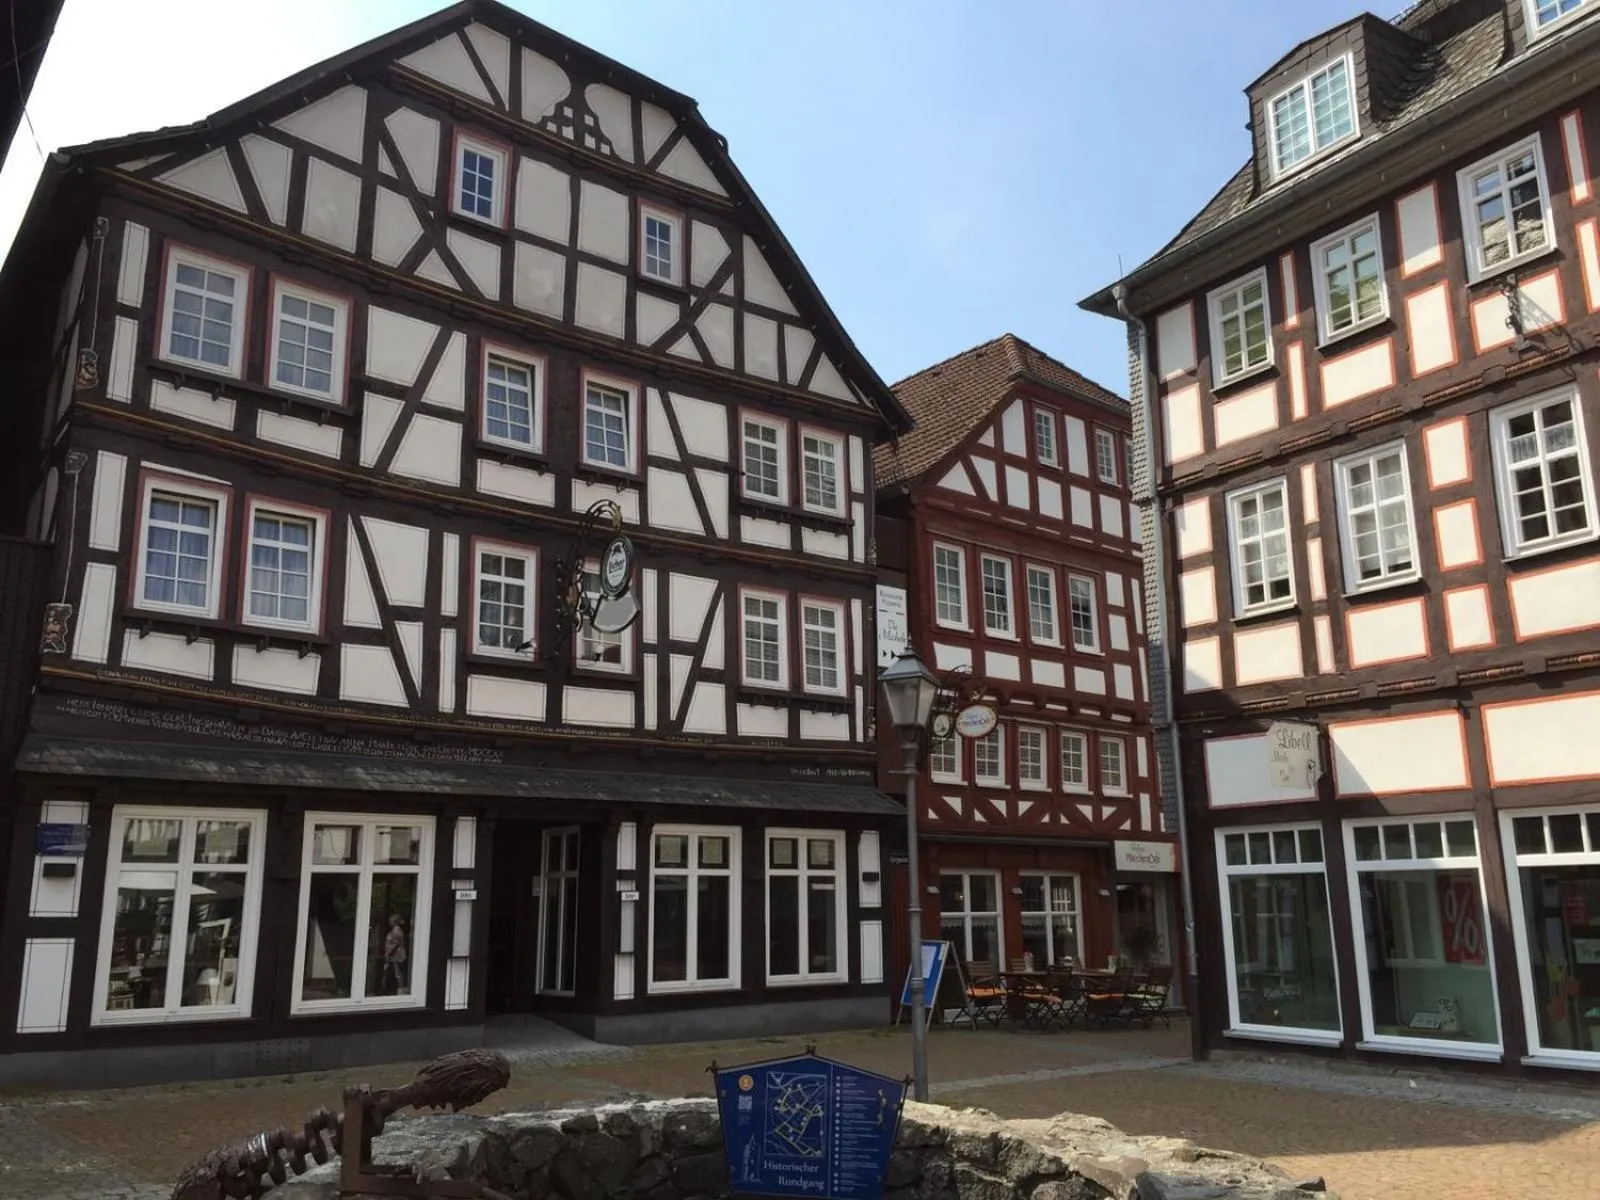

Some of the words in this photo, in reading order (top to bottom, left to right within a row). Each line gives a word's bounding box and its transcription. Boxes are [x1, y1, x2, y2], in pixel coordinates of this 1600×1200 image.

[1276, 728, 1312, 751] Libell
[764, 1160, 820, 1173] Historischer
[778, 1176, 825, 1191] Rundgang
